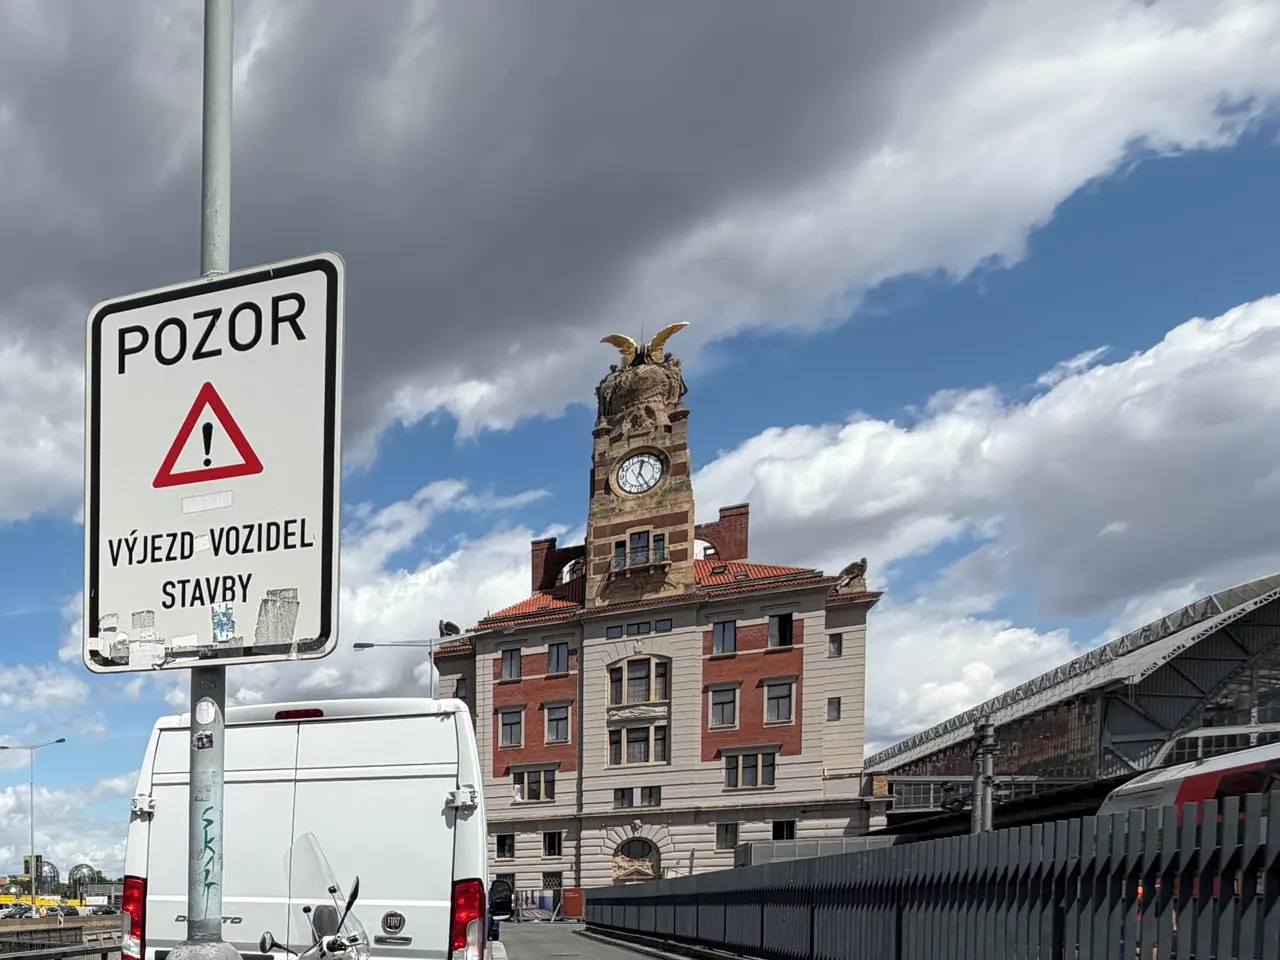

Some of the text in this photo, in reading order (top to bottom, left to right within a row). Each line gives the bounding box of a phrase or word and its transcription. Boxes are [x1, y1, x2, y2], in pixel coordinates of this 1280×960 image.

[118, 292, 307, 375] POZOR
[108, 518, 314, 567] VÝJEZD VOZIDEL
[161, 573, 253, 609] STAVBY
[175, 915, 243, 924] DTO
[387, 916, 401, 927] FIAT
